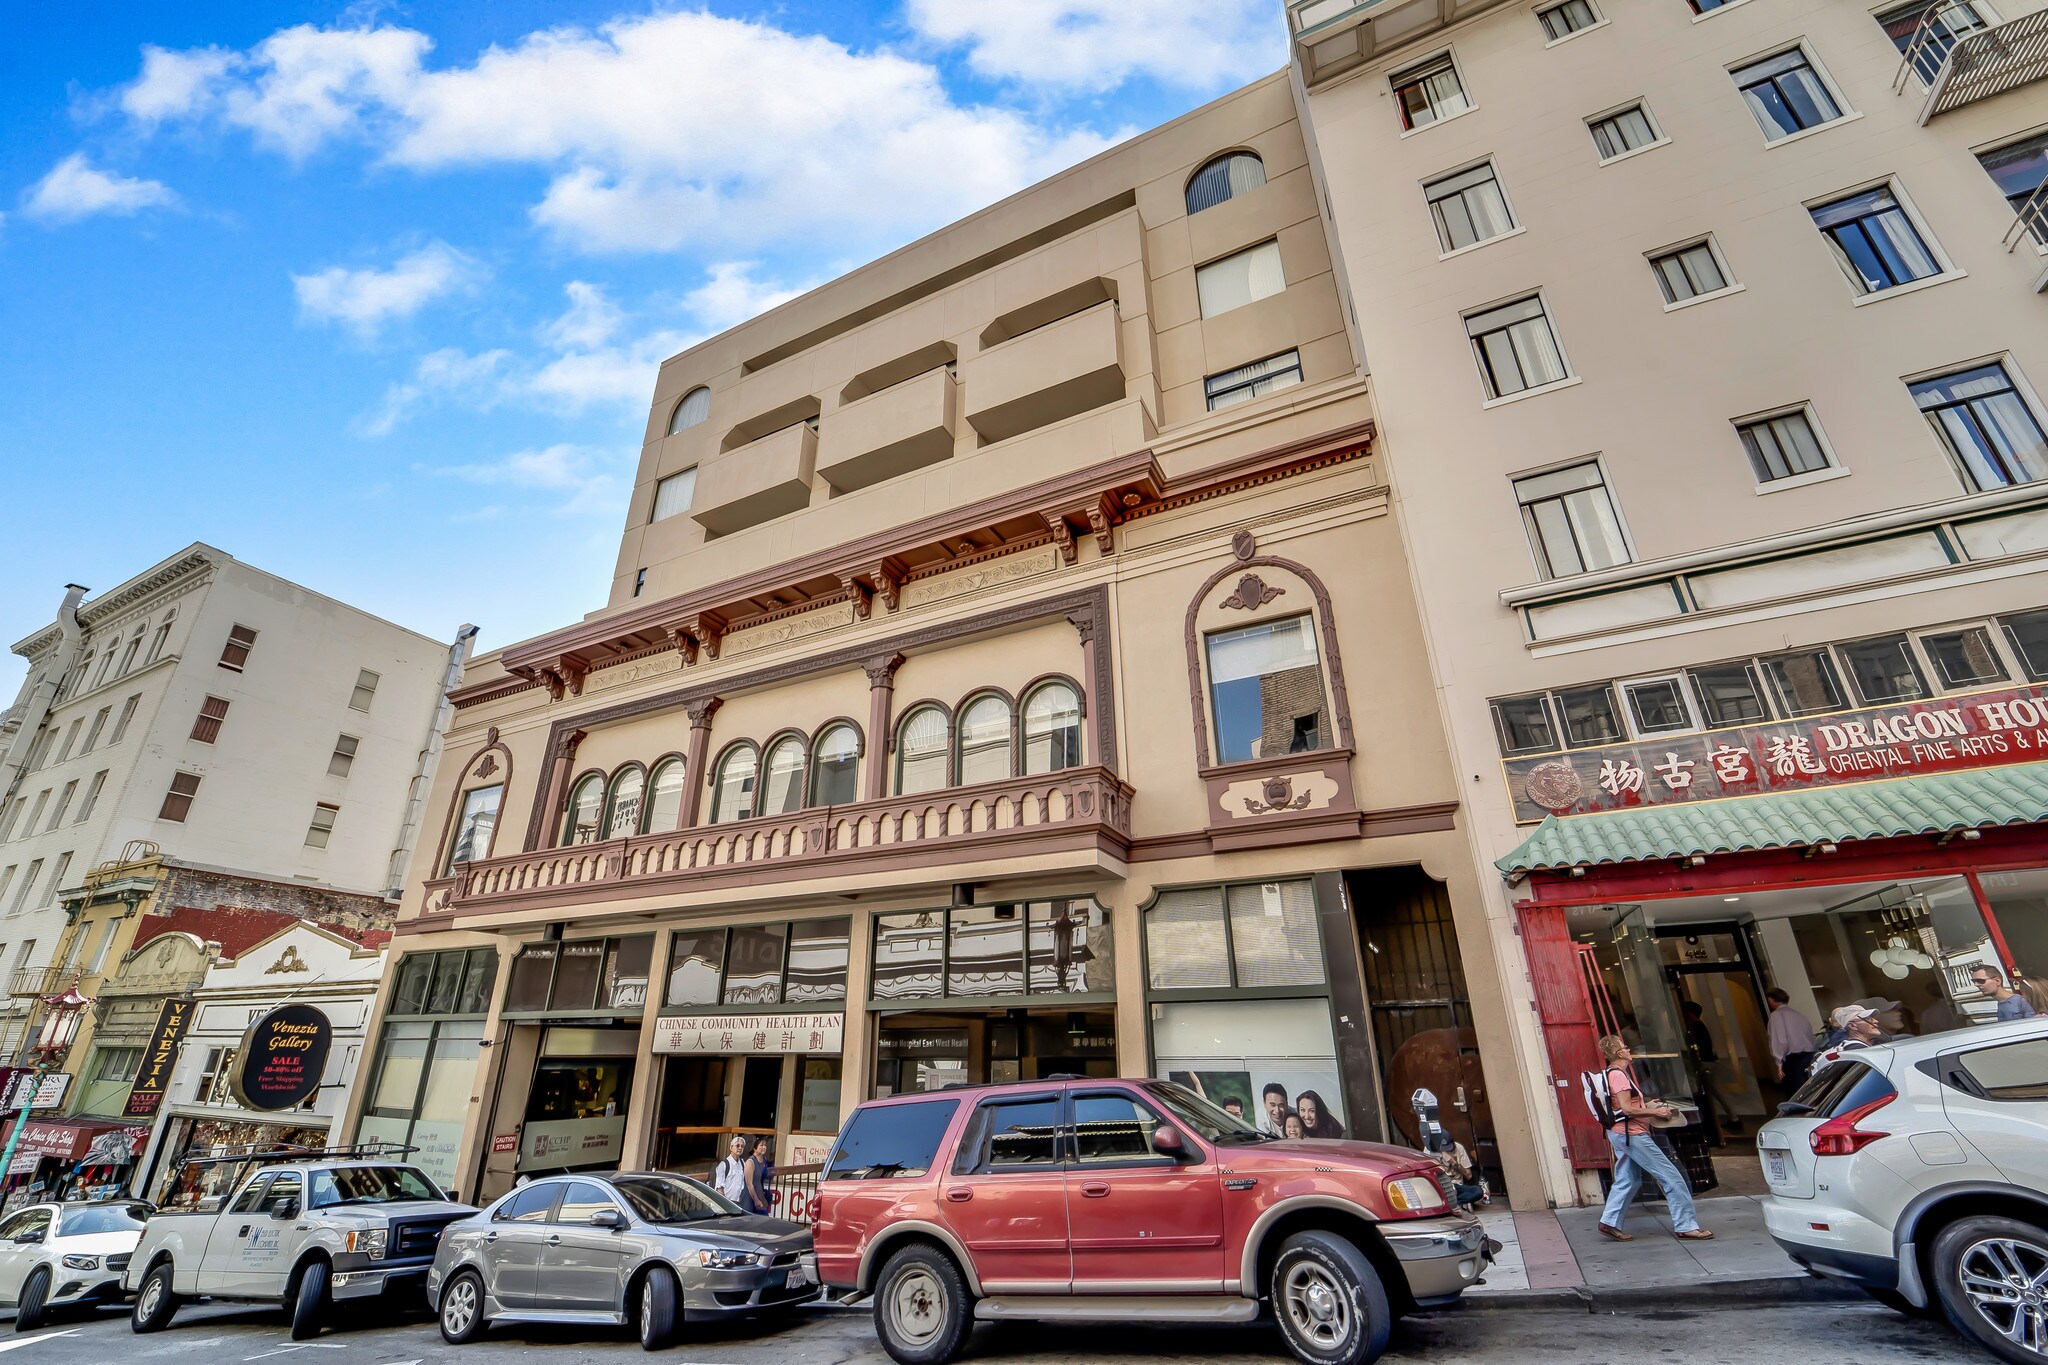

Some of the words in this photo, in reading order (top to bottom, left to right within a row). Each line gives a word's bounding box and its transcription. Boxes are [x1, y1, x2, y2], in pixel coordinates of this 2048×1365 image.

[1818, 708, 1968, 752] DRAGON
[1829, 747, 1911, 774] ORIENTAL
[1912, 741, 1956, 763] FINE
[1960, 734, 2009, 757] ARTS
[2014, 730, 2031, 748] &
[272, 1021, 319, 1034] Venezia
[659, 1018, 698, 1030] CHINESE
[701, 1017, 762, 1030] COMMUNITY
[766, 1016, 807, 1028] HEALTH
[812, 1015, 841, 1028] PLAN
[144, 1004, 187, 1088] VENEZIA
[269, 1036, 312, 1051] Gallery
[670, 1031, 824, 1050] 華人保健計劃
[935, 1038, 950, 1047] West
[272, 1057, 300, 1065] SALE
[496, 1143, 513, 1151] STAIRS
[549, 1136, 571, 1146] CCHP
[1225, 1178, 1258, 1187] EXPEDITION
